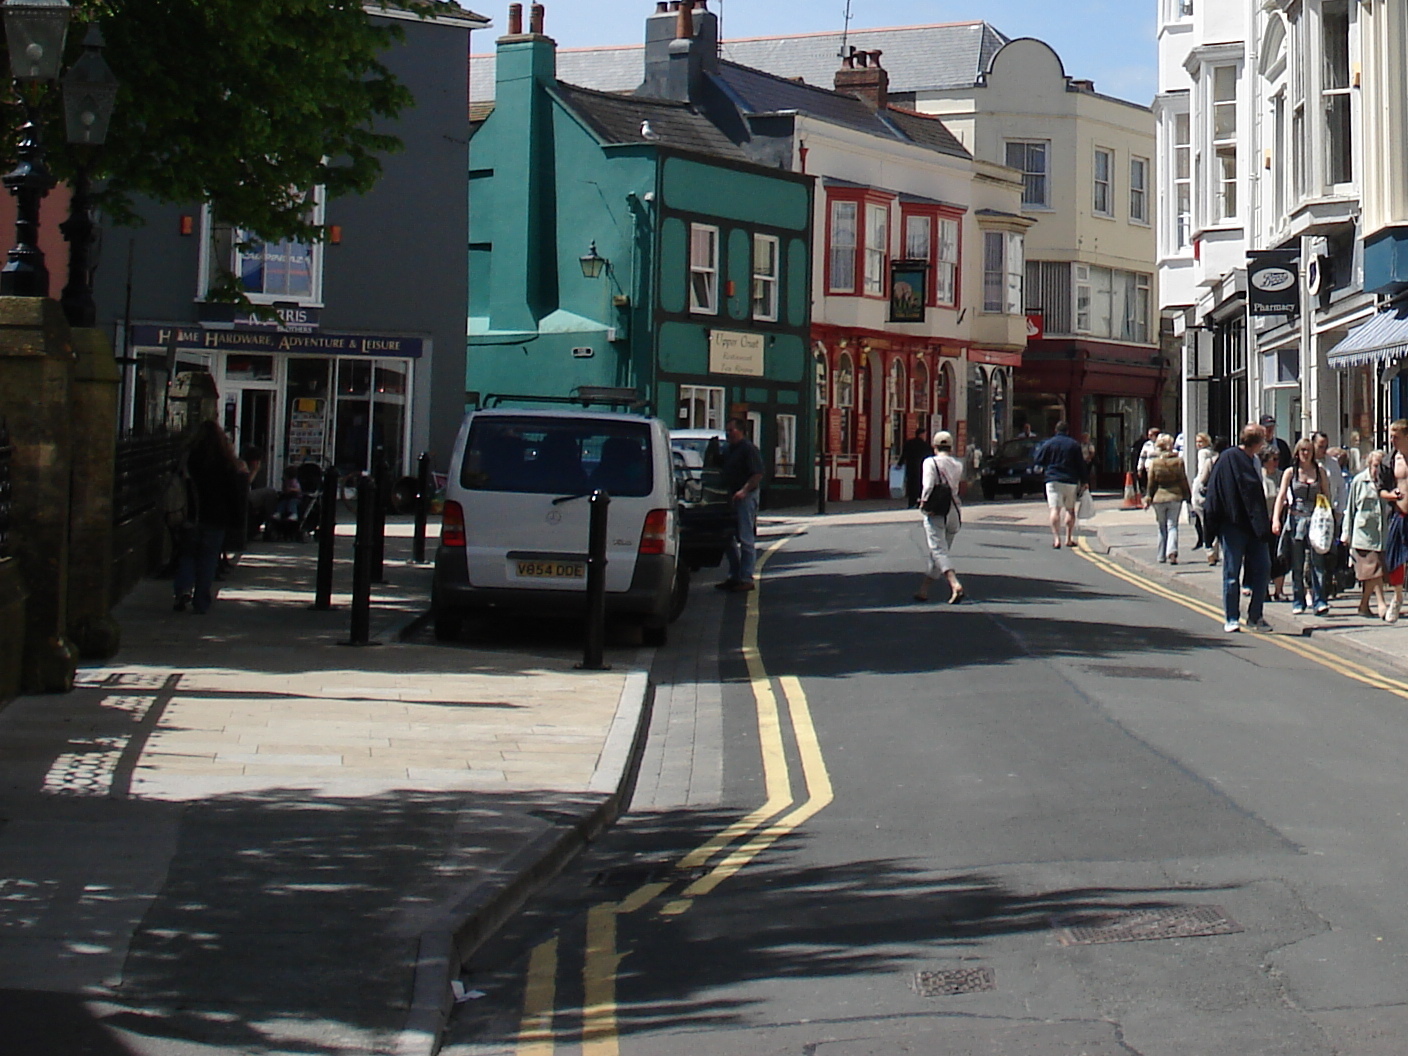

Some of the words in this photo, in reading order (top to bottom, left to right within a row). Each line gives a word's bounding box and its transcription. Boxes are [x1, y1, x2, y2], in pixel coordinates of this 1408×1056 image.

[1253, 303, 1295, 312] Pharmacy
[249, 308, 307, 326] MRRIS
[159, 329, 199, 345] HME
[205, 331, 274, 347] HARDWARE,
[279, 335, 345, 351] ADVENTURE
[349, 340, 357, 349] &
[362, 339, 401, 353] LEISURE
